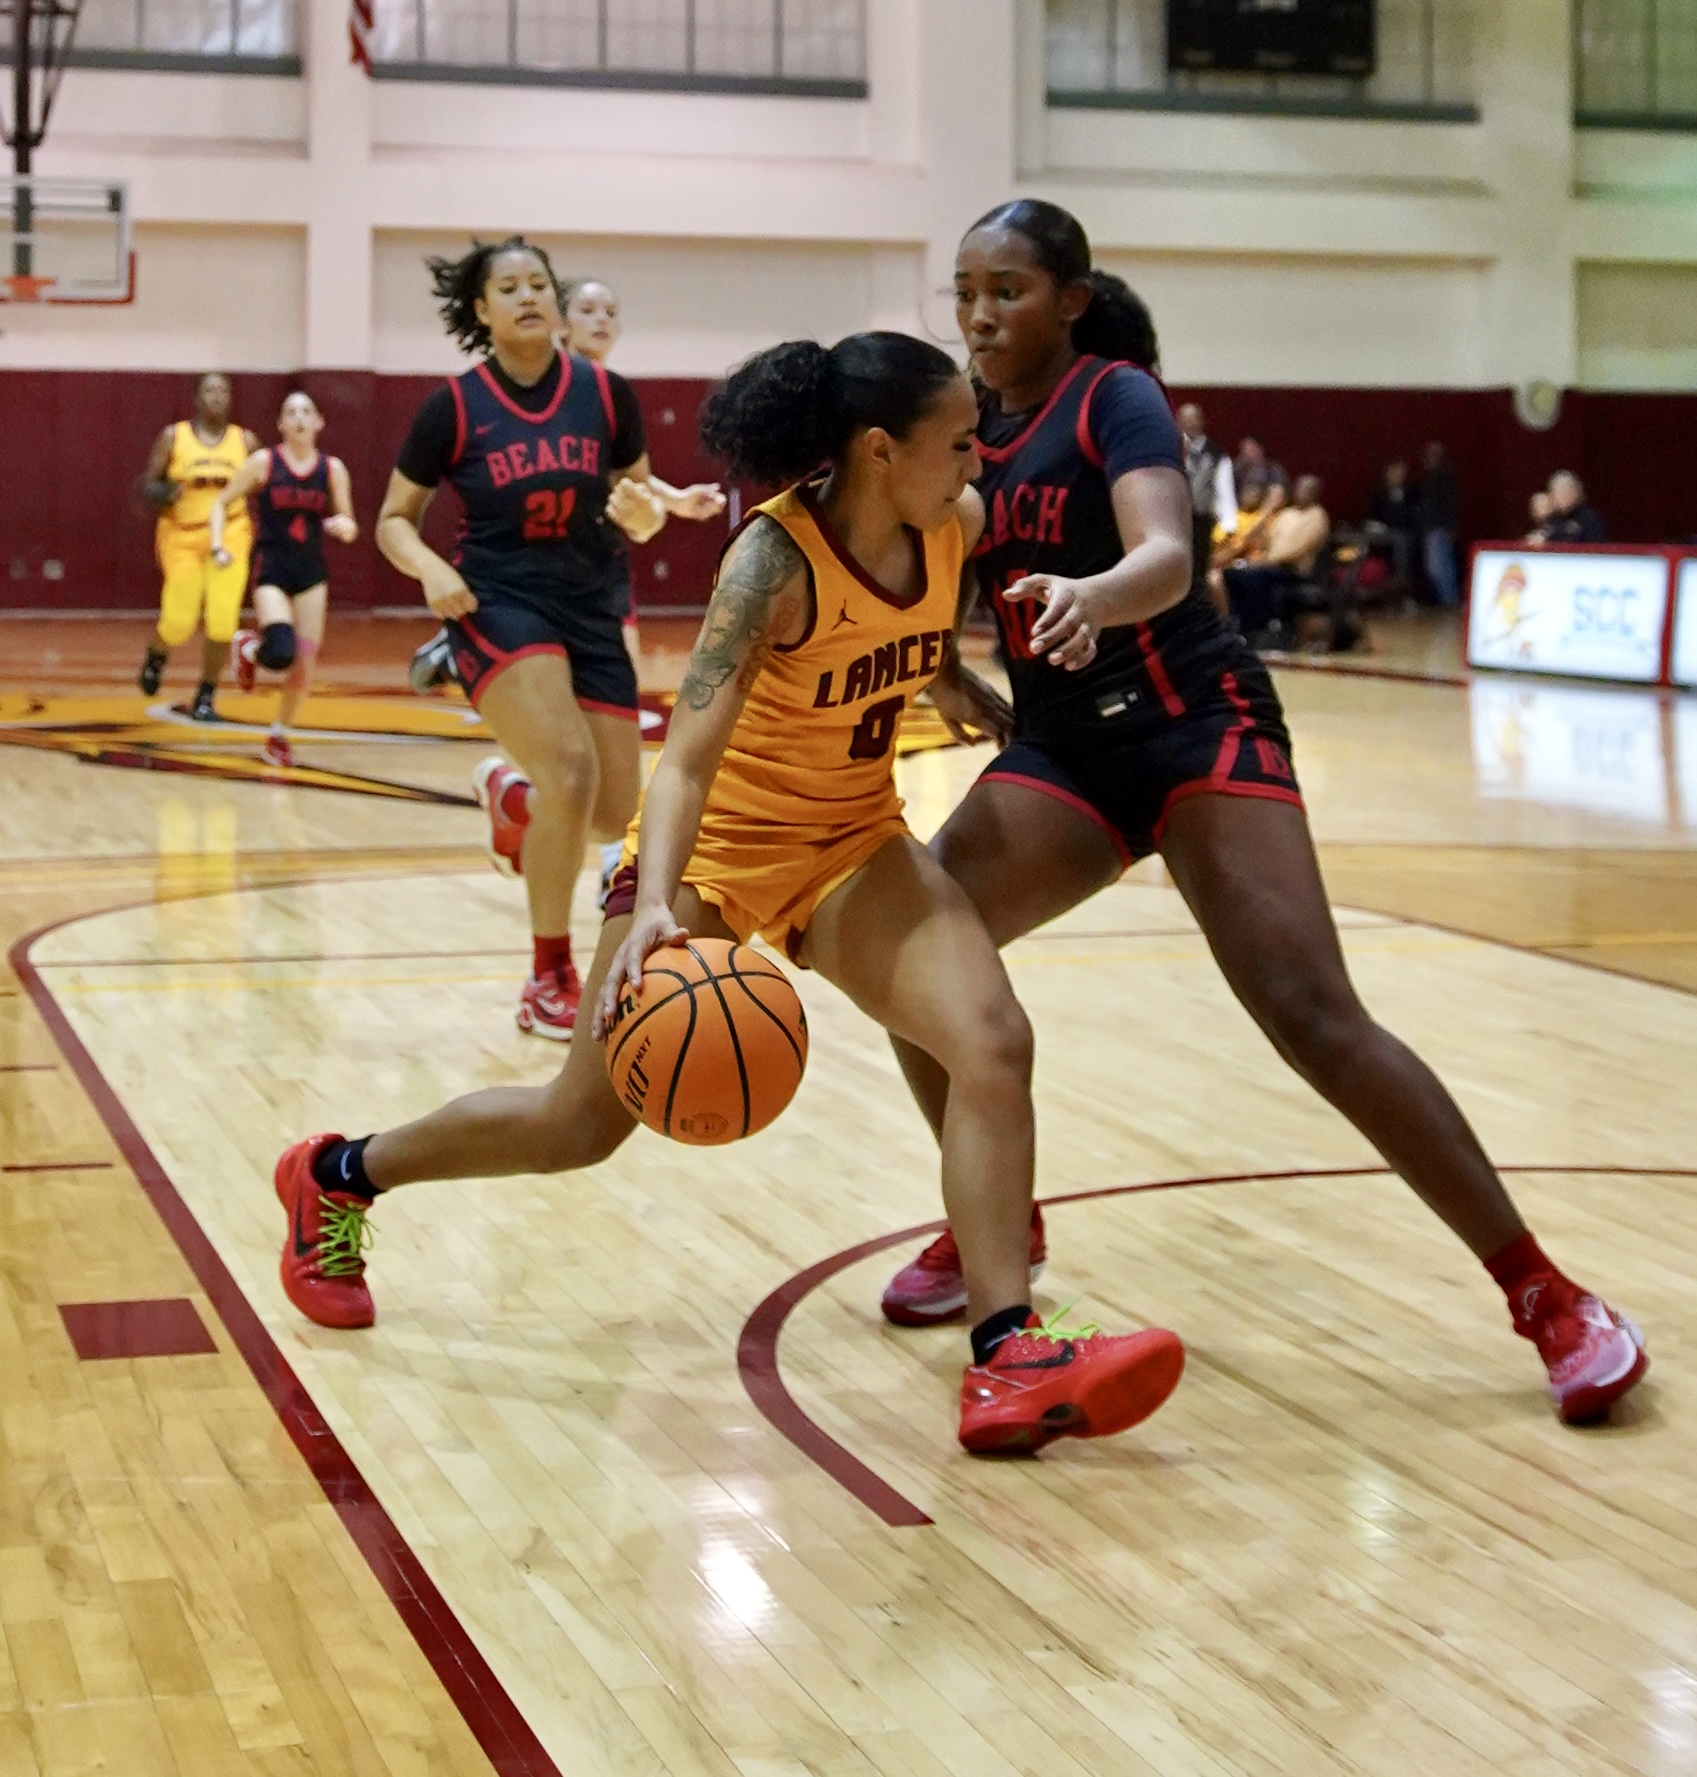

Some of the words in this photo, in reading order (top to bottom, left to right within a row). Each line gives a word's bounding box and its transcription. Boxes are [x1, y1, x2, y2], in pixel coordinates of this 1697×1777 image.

[486, 435, 600, 488] BEACH
[523, 487, 577, 539] 21
[848, 694, 905, 761] 0
[624, 1060, 649, 1113] VO
